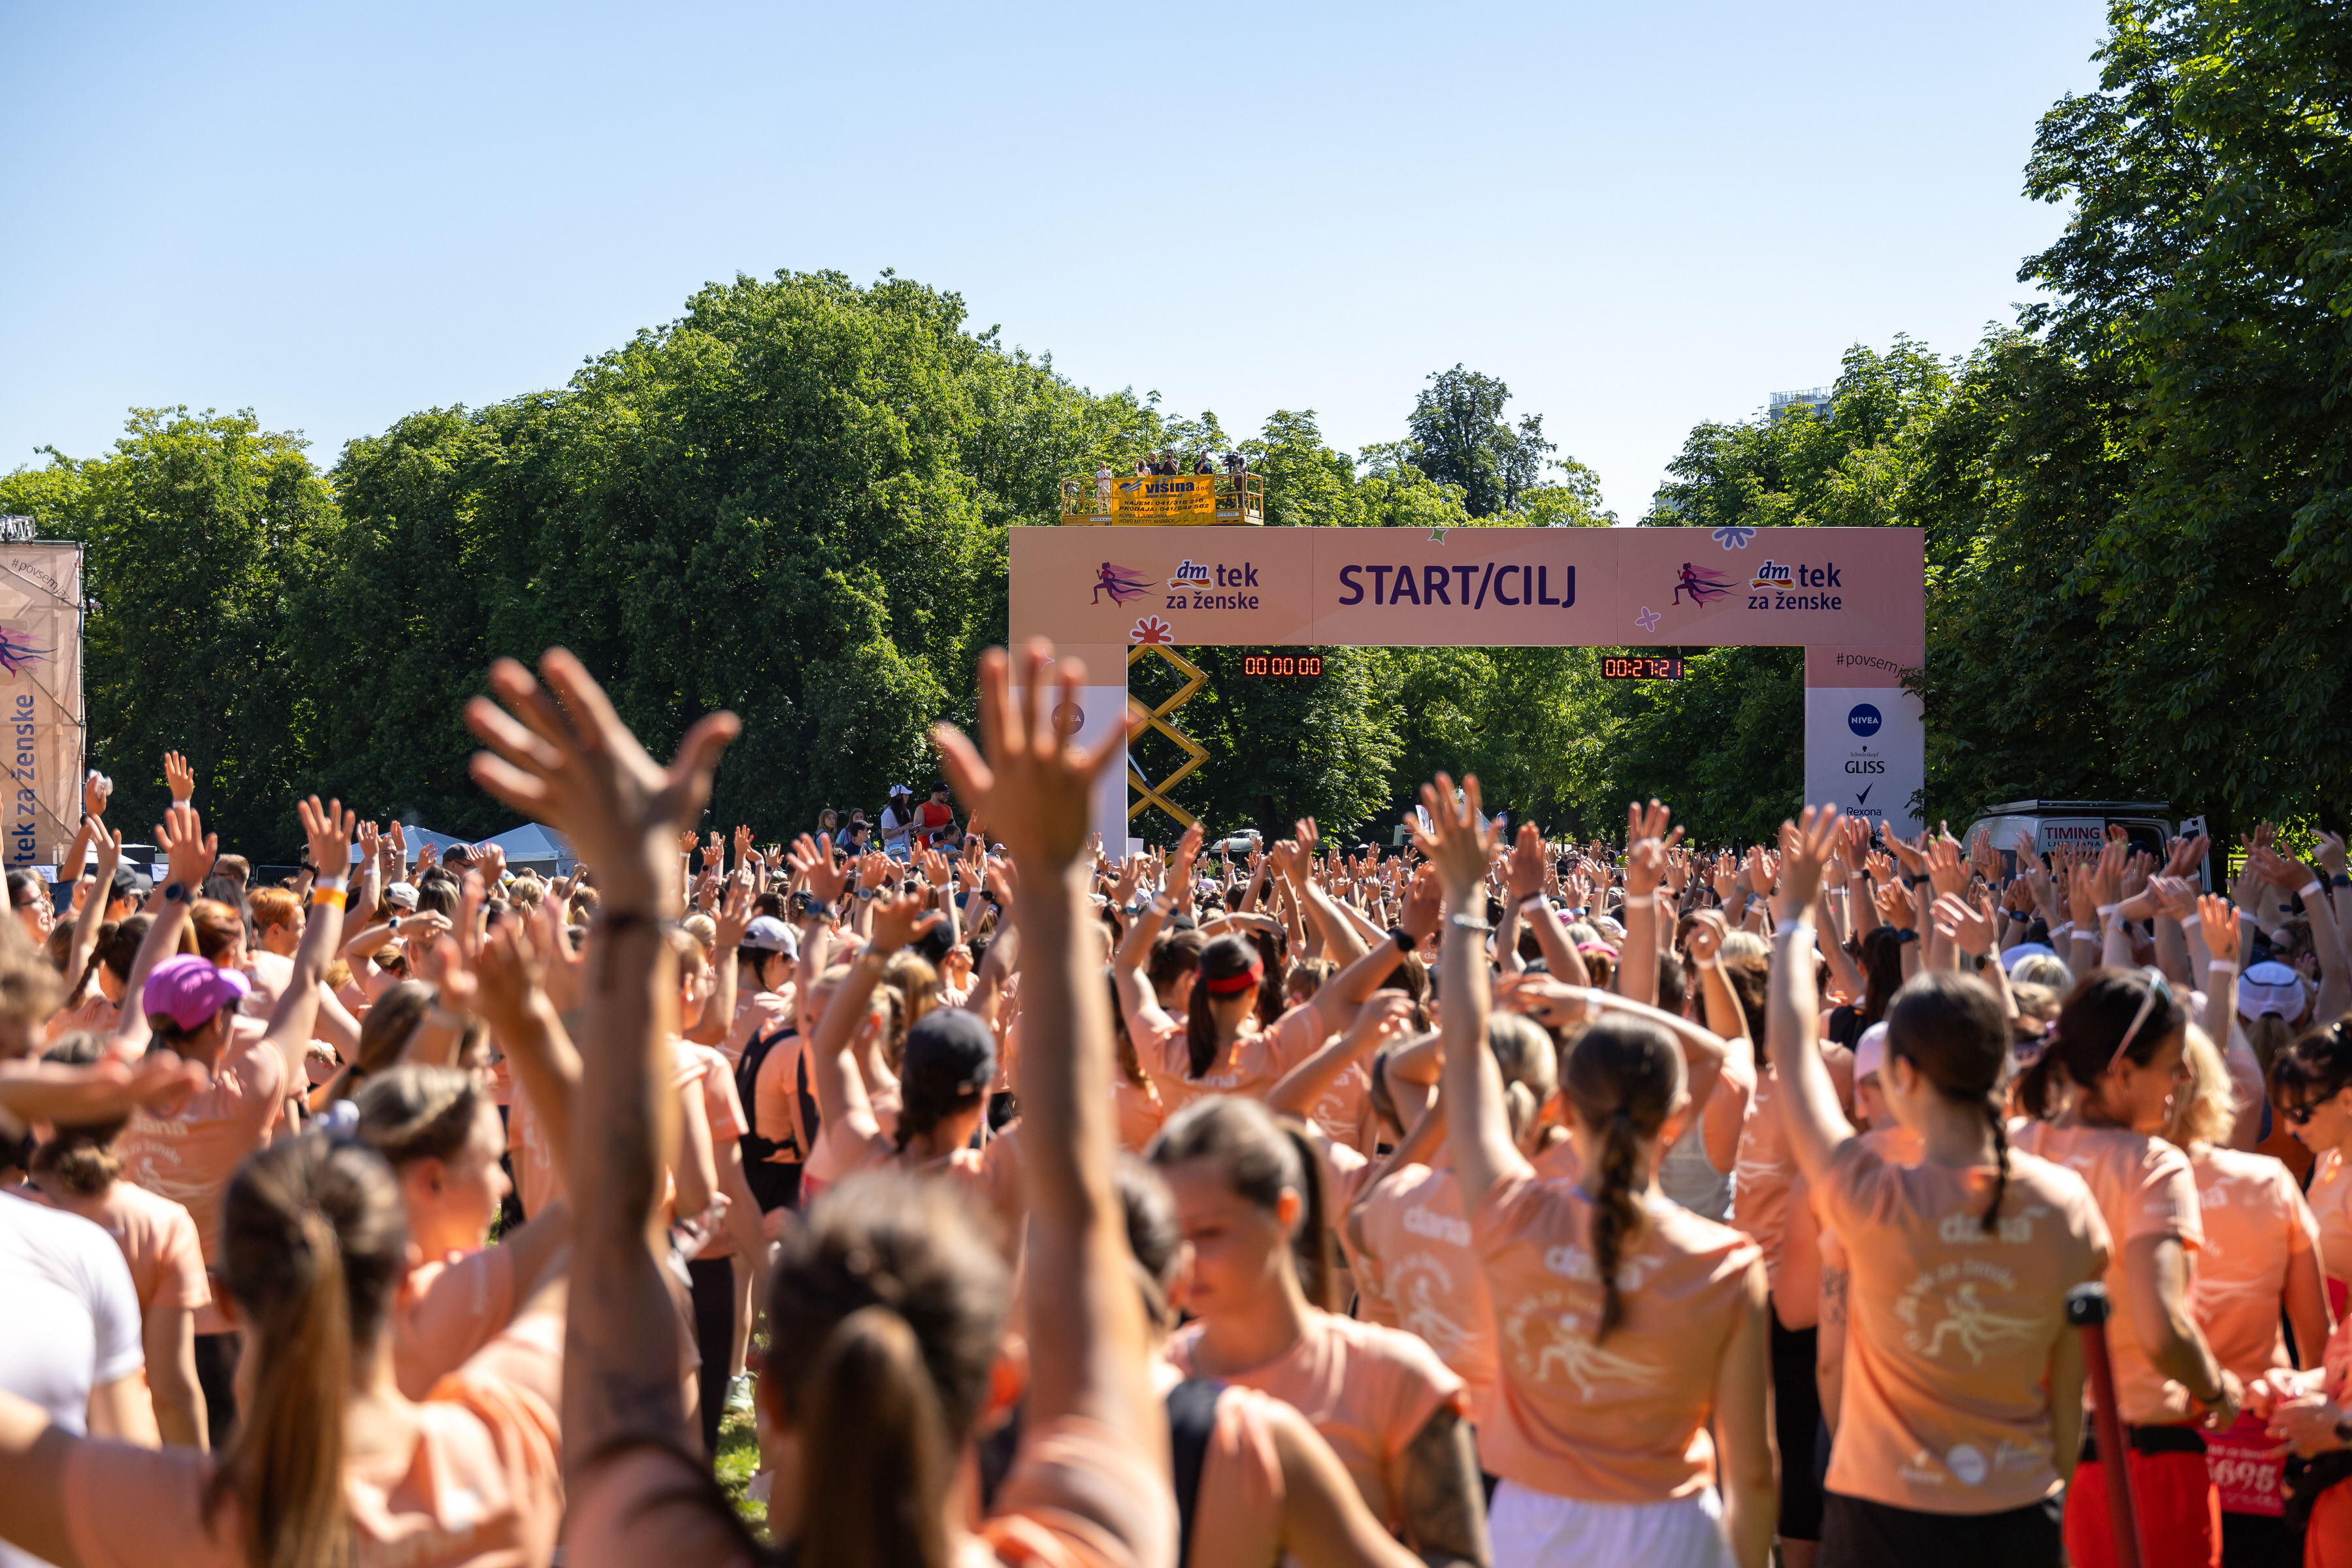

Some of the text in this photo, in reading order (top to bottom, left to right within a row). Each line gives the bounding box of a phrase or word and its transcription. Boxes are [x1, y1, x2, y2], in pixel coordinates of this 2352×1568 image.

[12, 558, 70, 602] #povsemjaz
[1177, 559, 1258, 587] dm tek
[1758, 561, 1841, 587] dm tek
[1339, 562, 1576, 610] START/CILJ
[1166, 591, 1259, 610] za ženske
[1748, 591, 1842, 610] za ženske
[1245, 657, 1320, 675] 00 00 00
[1605, 659, 1681, 677] 00:27:21
[1845, 760, 1885, 774] GLISS
[10, 694, 36, 862] tek za ženske
[1846, 807, 1882, 816] Rexona
[2044, 826, 2100, 840] TIMING
